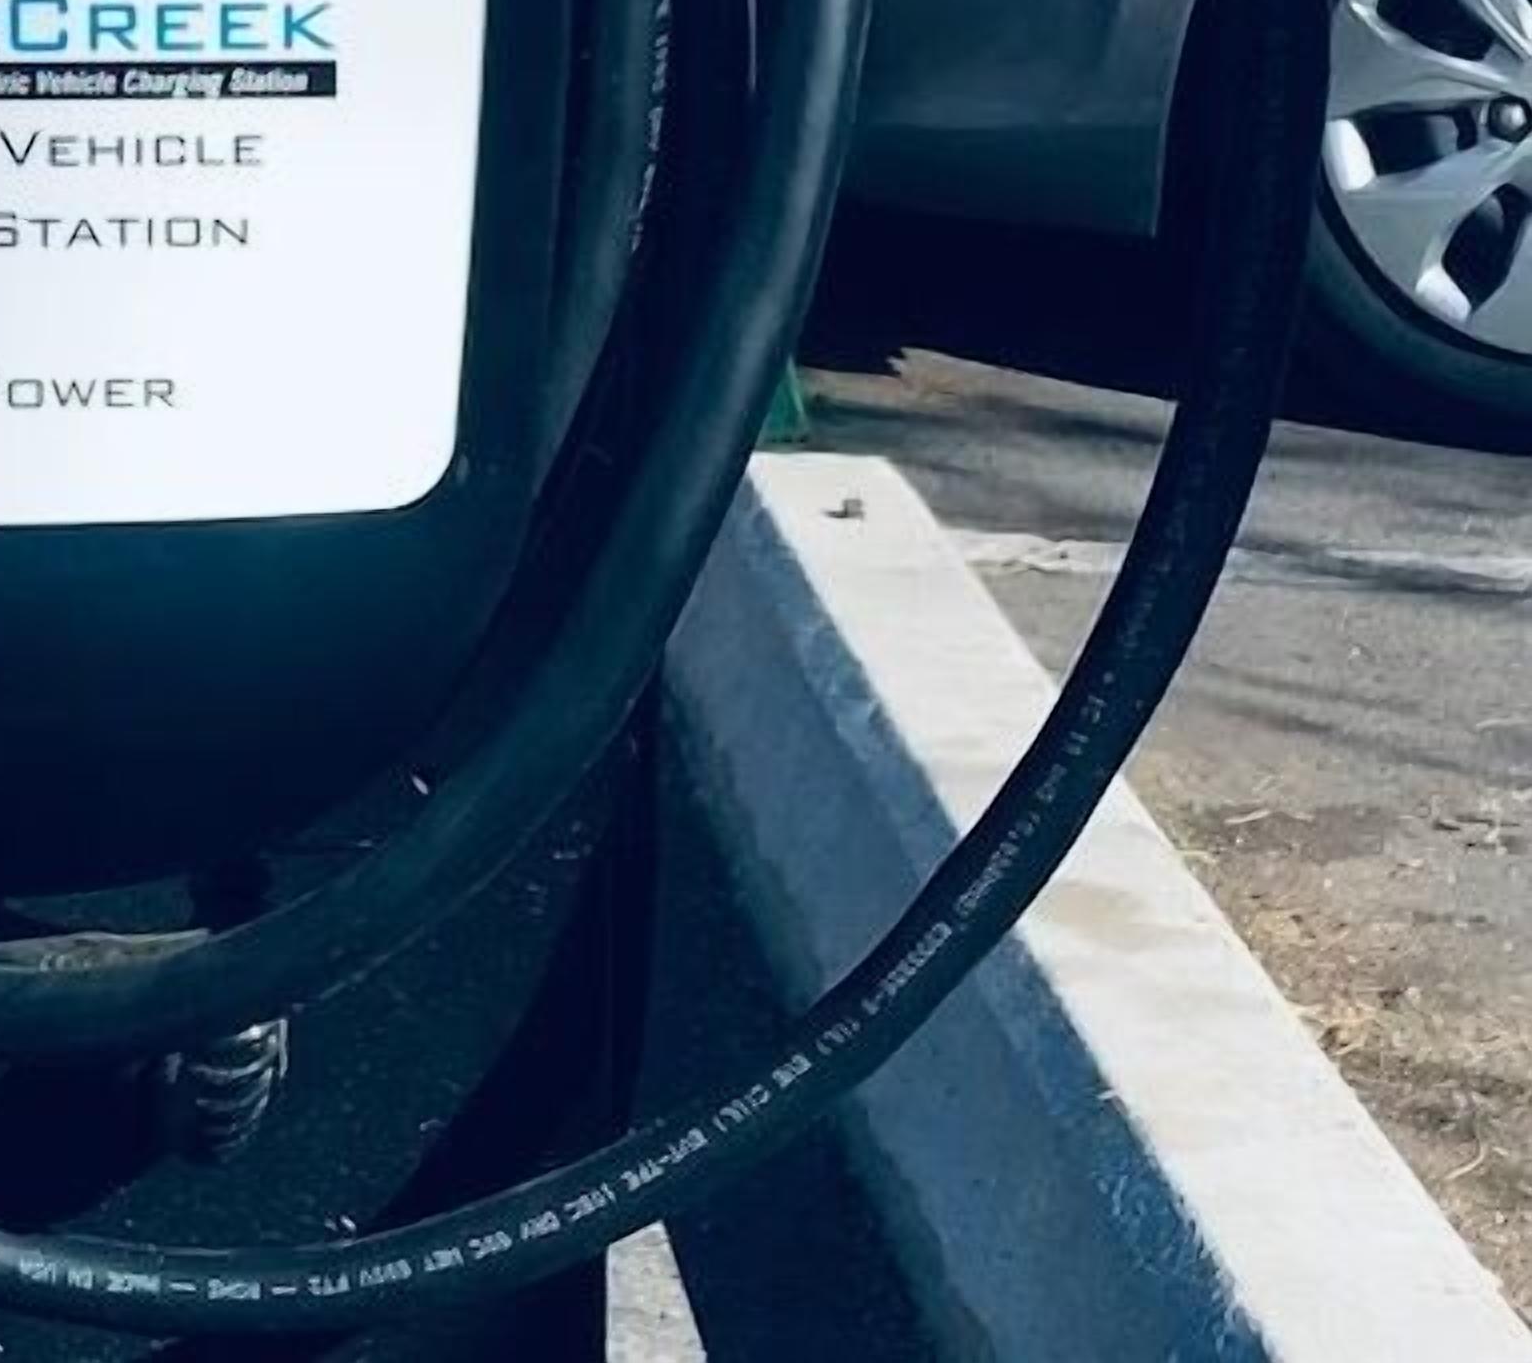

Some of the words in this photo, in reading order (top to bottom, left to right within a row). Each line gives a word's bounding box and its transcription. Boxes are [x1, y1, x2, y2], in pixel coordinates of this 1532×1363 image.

[36, 70, 116, 95] Vehicle
[123, 69, 223, 97] Charging
[229, 68, 308, 94] Station
